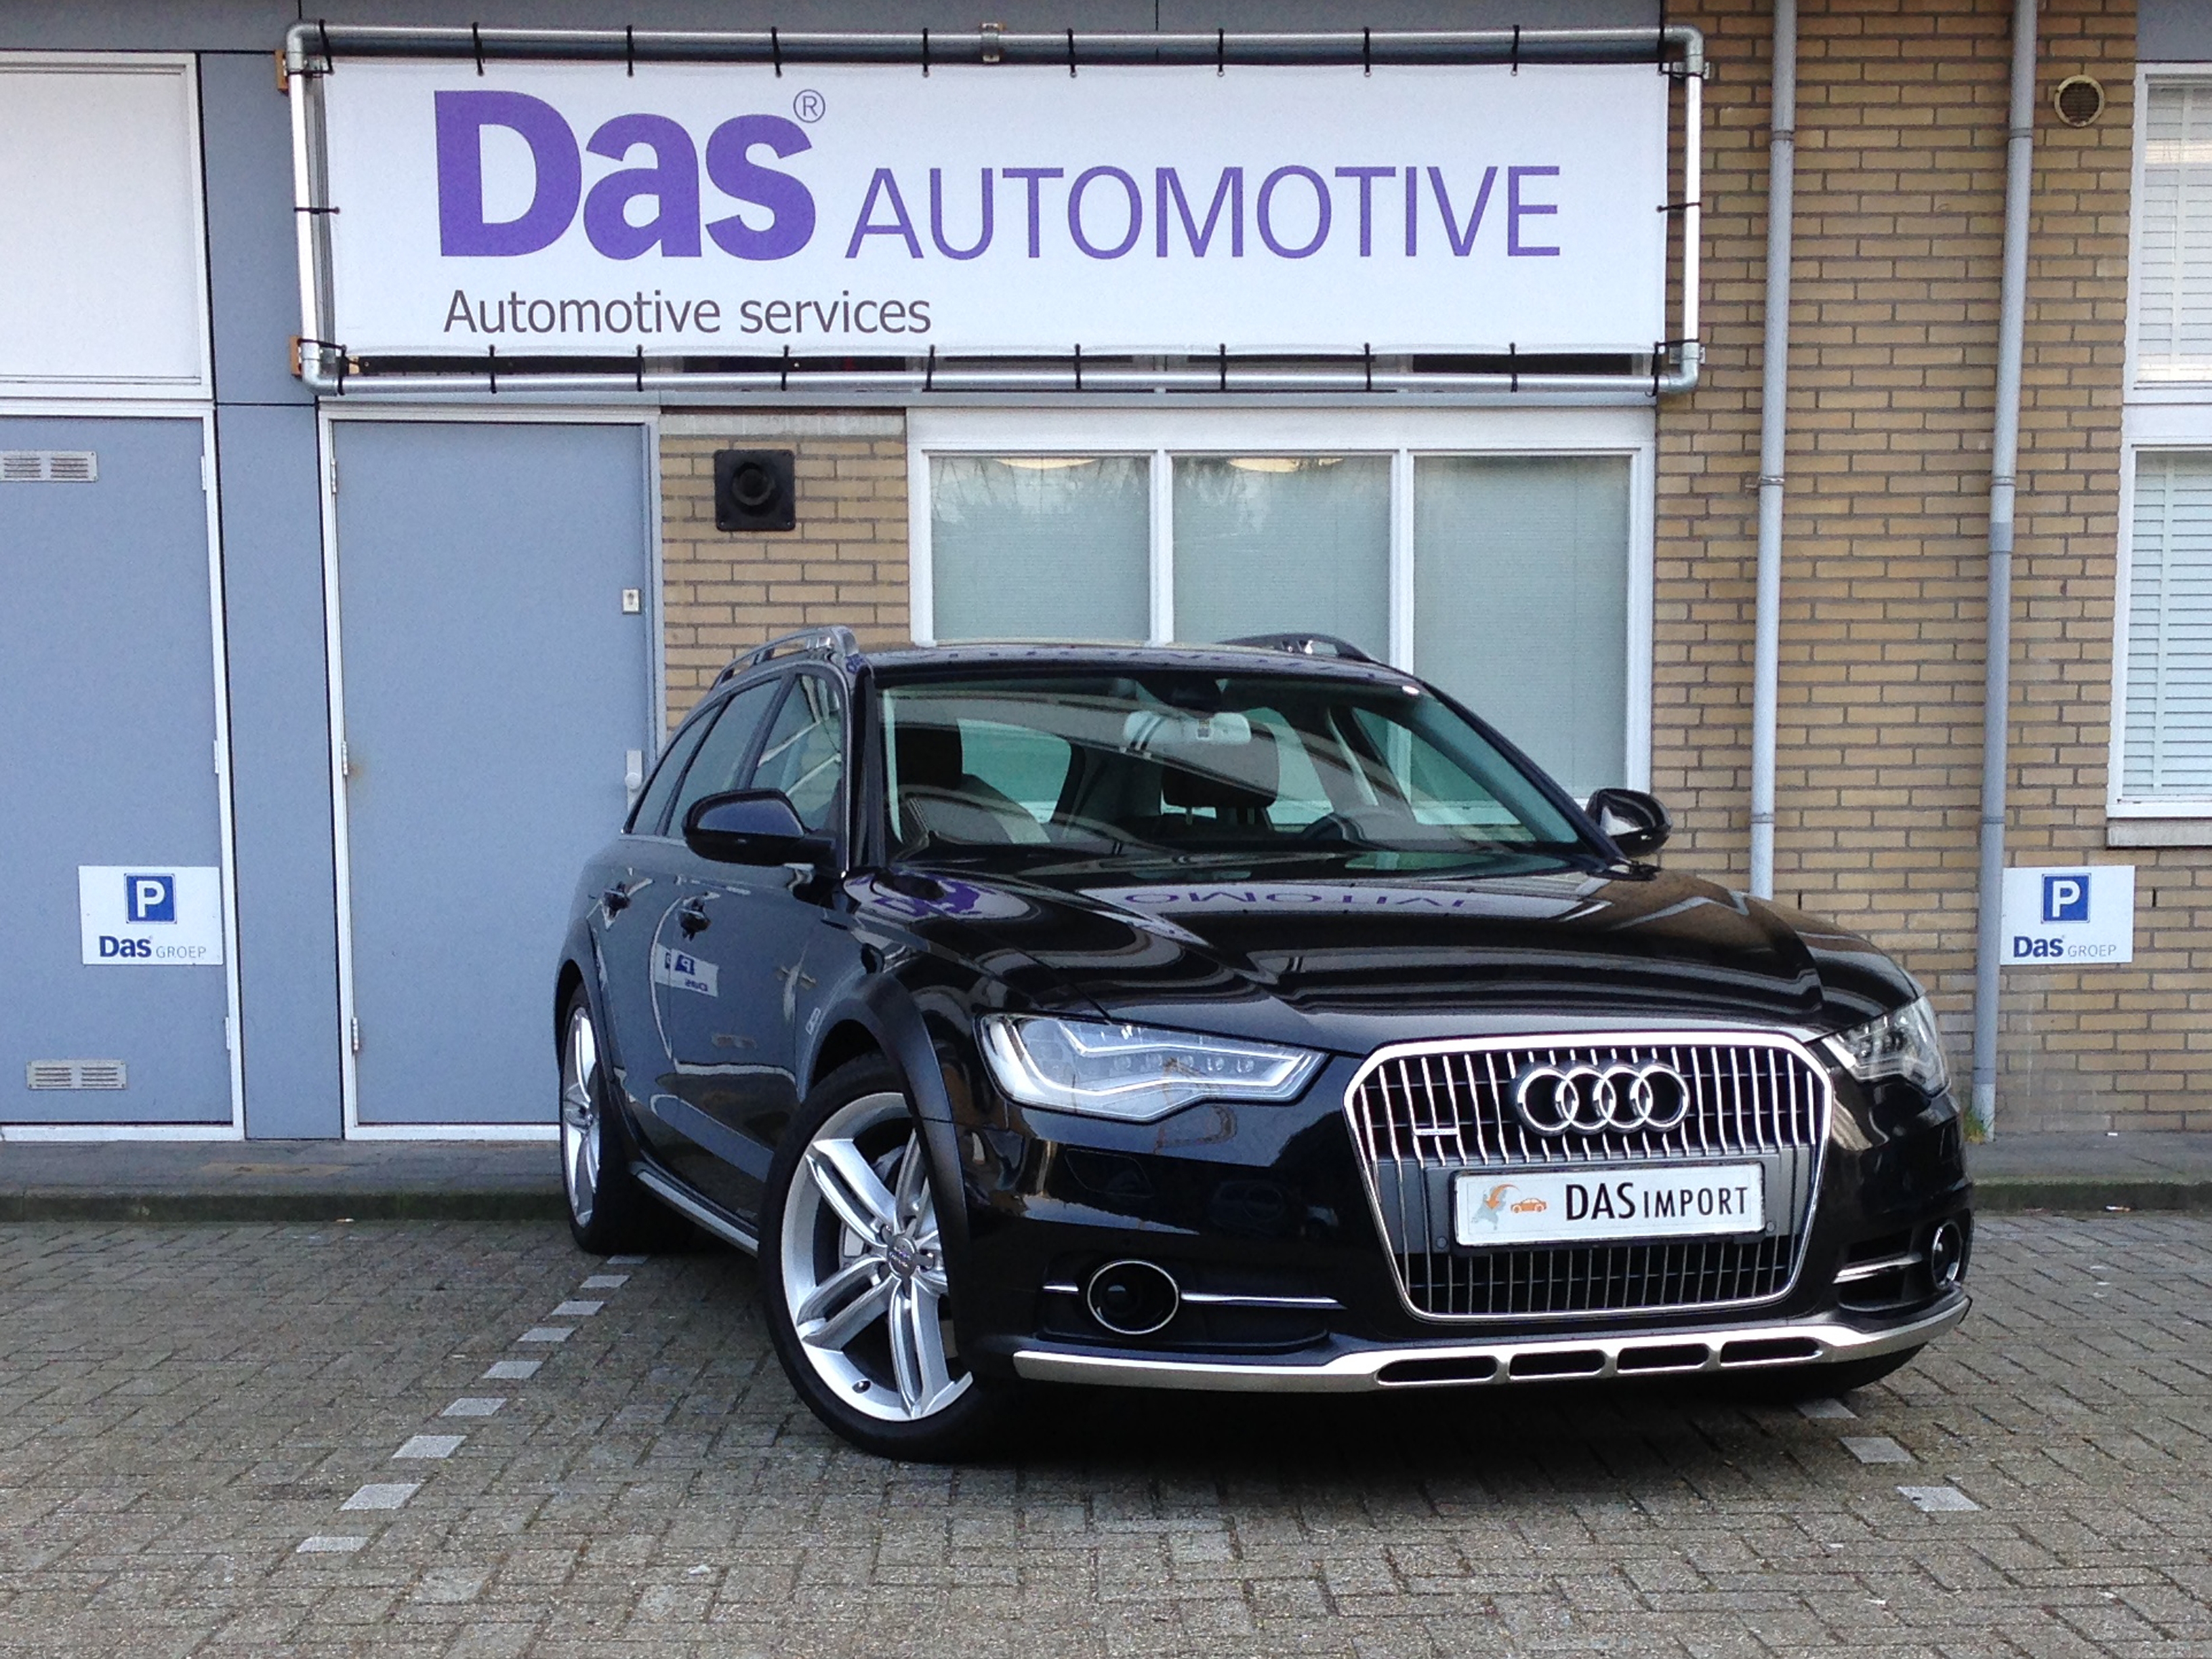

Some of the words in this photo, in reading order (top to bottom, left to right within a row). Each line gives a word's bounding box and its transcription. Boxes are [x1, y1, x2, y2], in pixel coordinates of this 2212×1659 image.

[844, 165, 1561, 260] AUTOMOTIVE
[443, 289, 720, 333] Automotive
[739, 289, 931, 334] services
[136, 880, 165, 918] P
[2052, 880, 2081, 917] P
[99, 935, 152, 958] Das
[155, 945, 207, 959] GROEP
[2013, 935, 2064, 958] Das
[2067, 944, 2117, 958] GROEP
[1565, 1182, 1637, 1222] DAS
[1643, 1187, 1749, 1219] IMPORT
